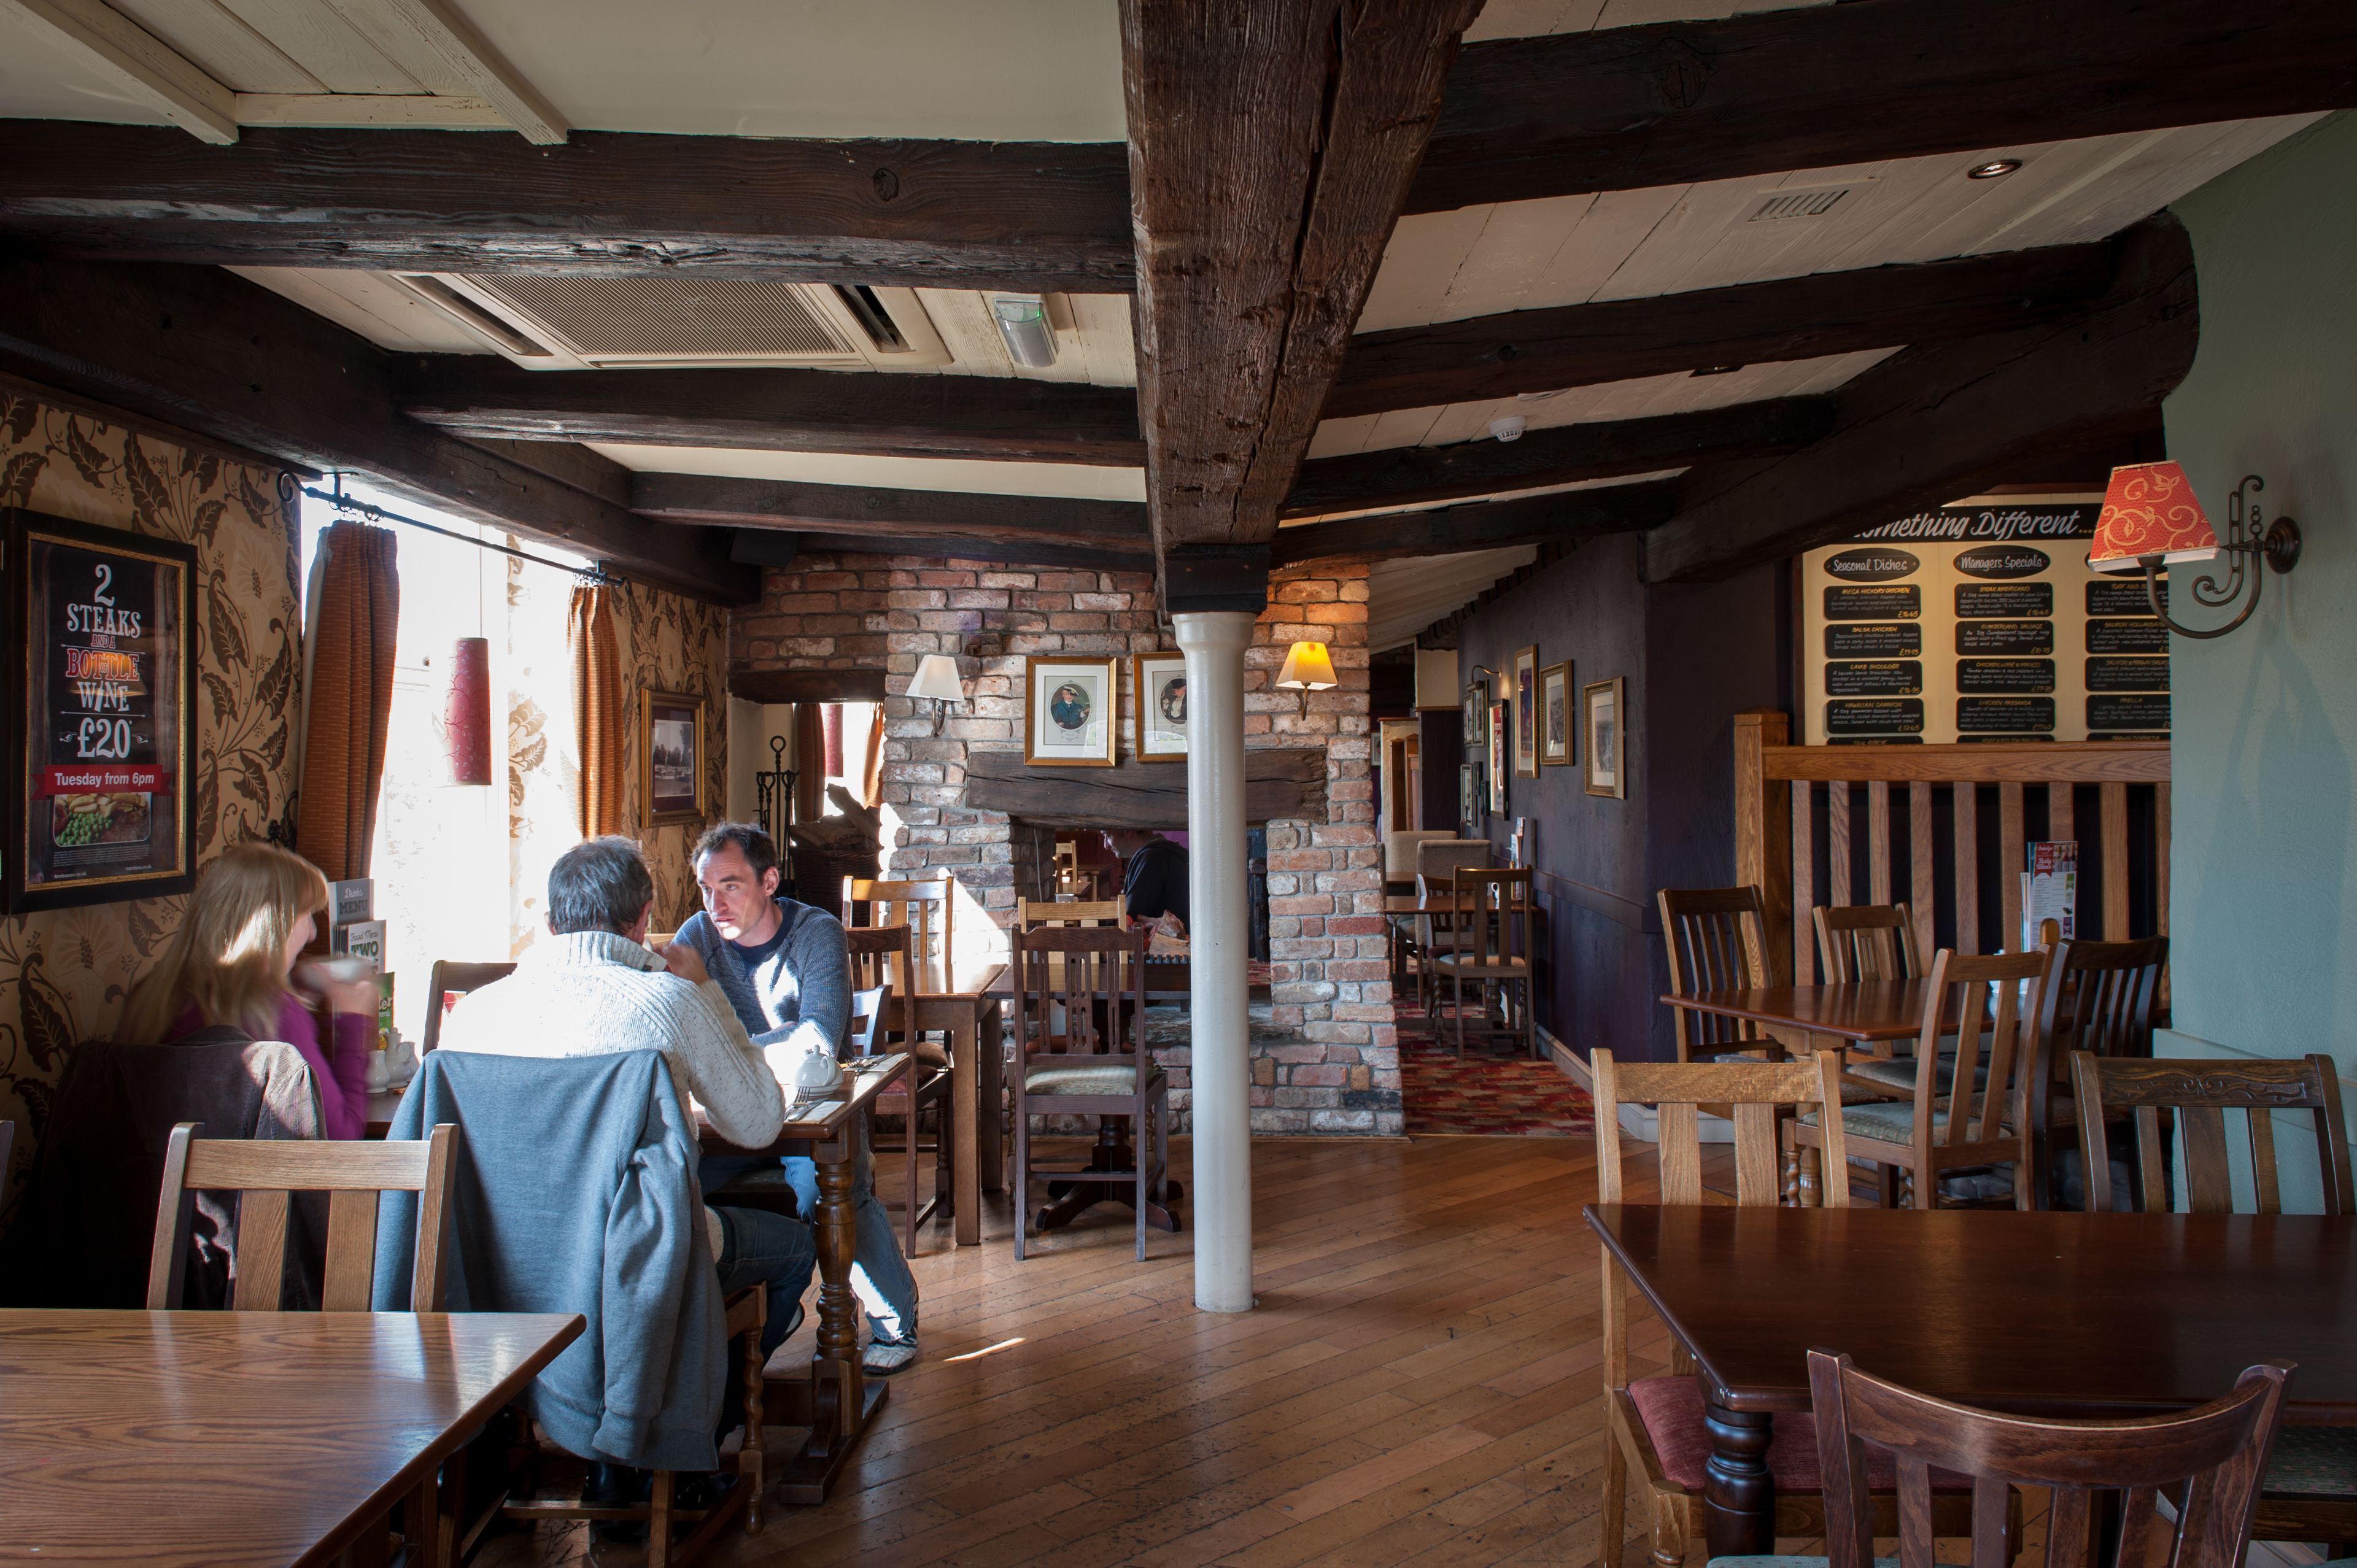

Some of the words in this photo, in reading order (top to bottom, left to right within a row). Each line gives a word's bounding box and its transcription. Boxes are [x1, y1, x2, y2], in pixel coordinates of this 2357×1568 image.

[1854, 512, 1971, 540] omething
[1833, 559, 1871, 571] Seasonal
[1873, 559, 1908, 571] Dishes
[1961, 557, 2003, 571] Managers
[2005, 555, 2042, 569] Specials
[95, 564, 115, 607] 2
[67, 603, 142, 639] STEAKS
[91, 634, 109, 649] AND
[108, 636, 116, 649] A
[66, 648, 140, 681] BOTTLE
[101, 663, 107, 673] OF
[77, 680, 130, 713] WINE
[55, 772, 102, 788] Tuesday
[104, 772, 130, 786] from
[132, 772, 155, 787] 6pm
[344, 887, 363, 899] Drinks
[339, 899, 368, 915] MENU
[350, 931, 363, 942] Food
[364, 929, 379, 939] Menu
[351, 940, 379, 957] TWO
